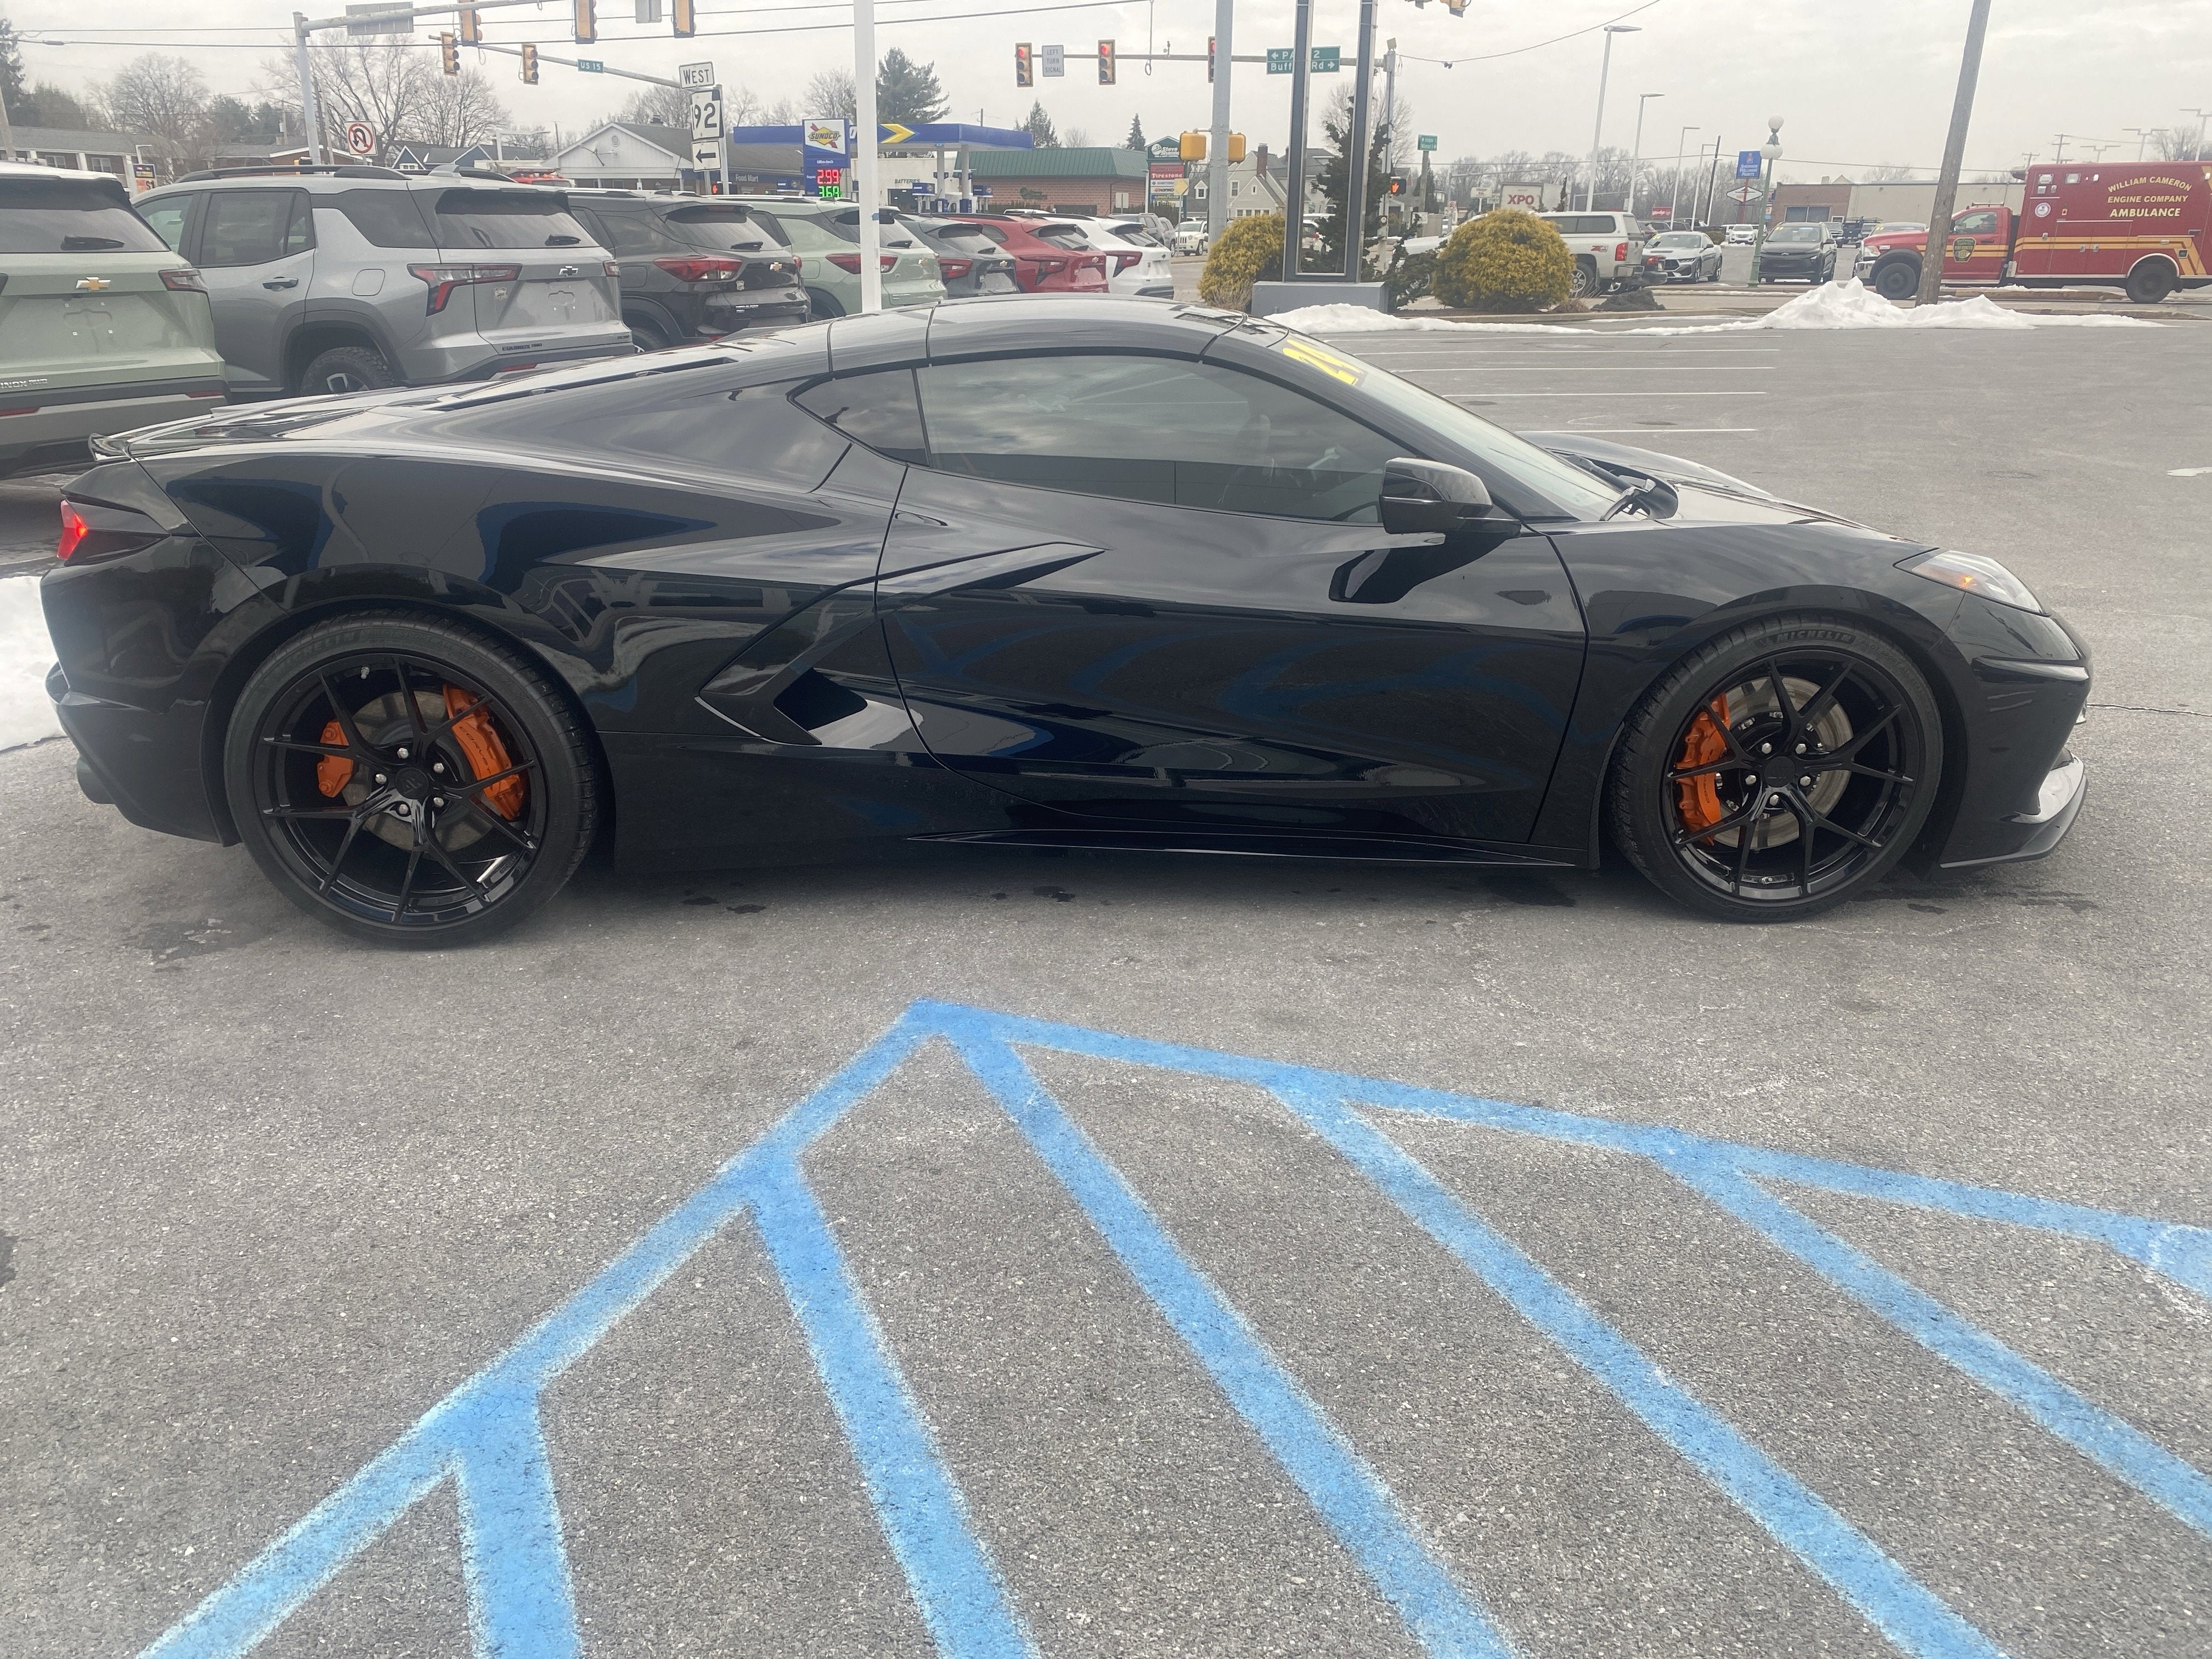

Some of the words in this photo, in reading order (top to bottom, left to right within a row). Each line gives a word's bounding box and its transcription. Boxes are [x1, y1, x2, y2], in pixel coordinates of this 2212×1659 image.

[1271, 62, 1293, 71] Buff
[1311, 61, 1324, 70] Rd
[683, 69, 710, 84] WEST
[2107, 177, 2147, 193] WILLIAM
[2149, 176, 2192, 192] CAMERON
[1508, 194, 1534, 205] XPO
[2107, 195, 2142, 204] ENGINE
[2143, 195, 2189, 203] COMPANY
[2109, 207, 2181, 218] AMBULANCE
[0, 380, 27, 389] INOX
[1778, 630, 1853, 643] MICHELIN
